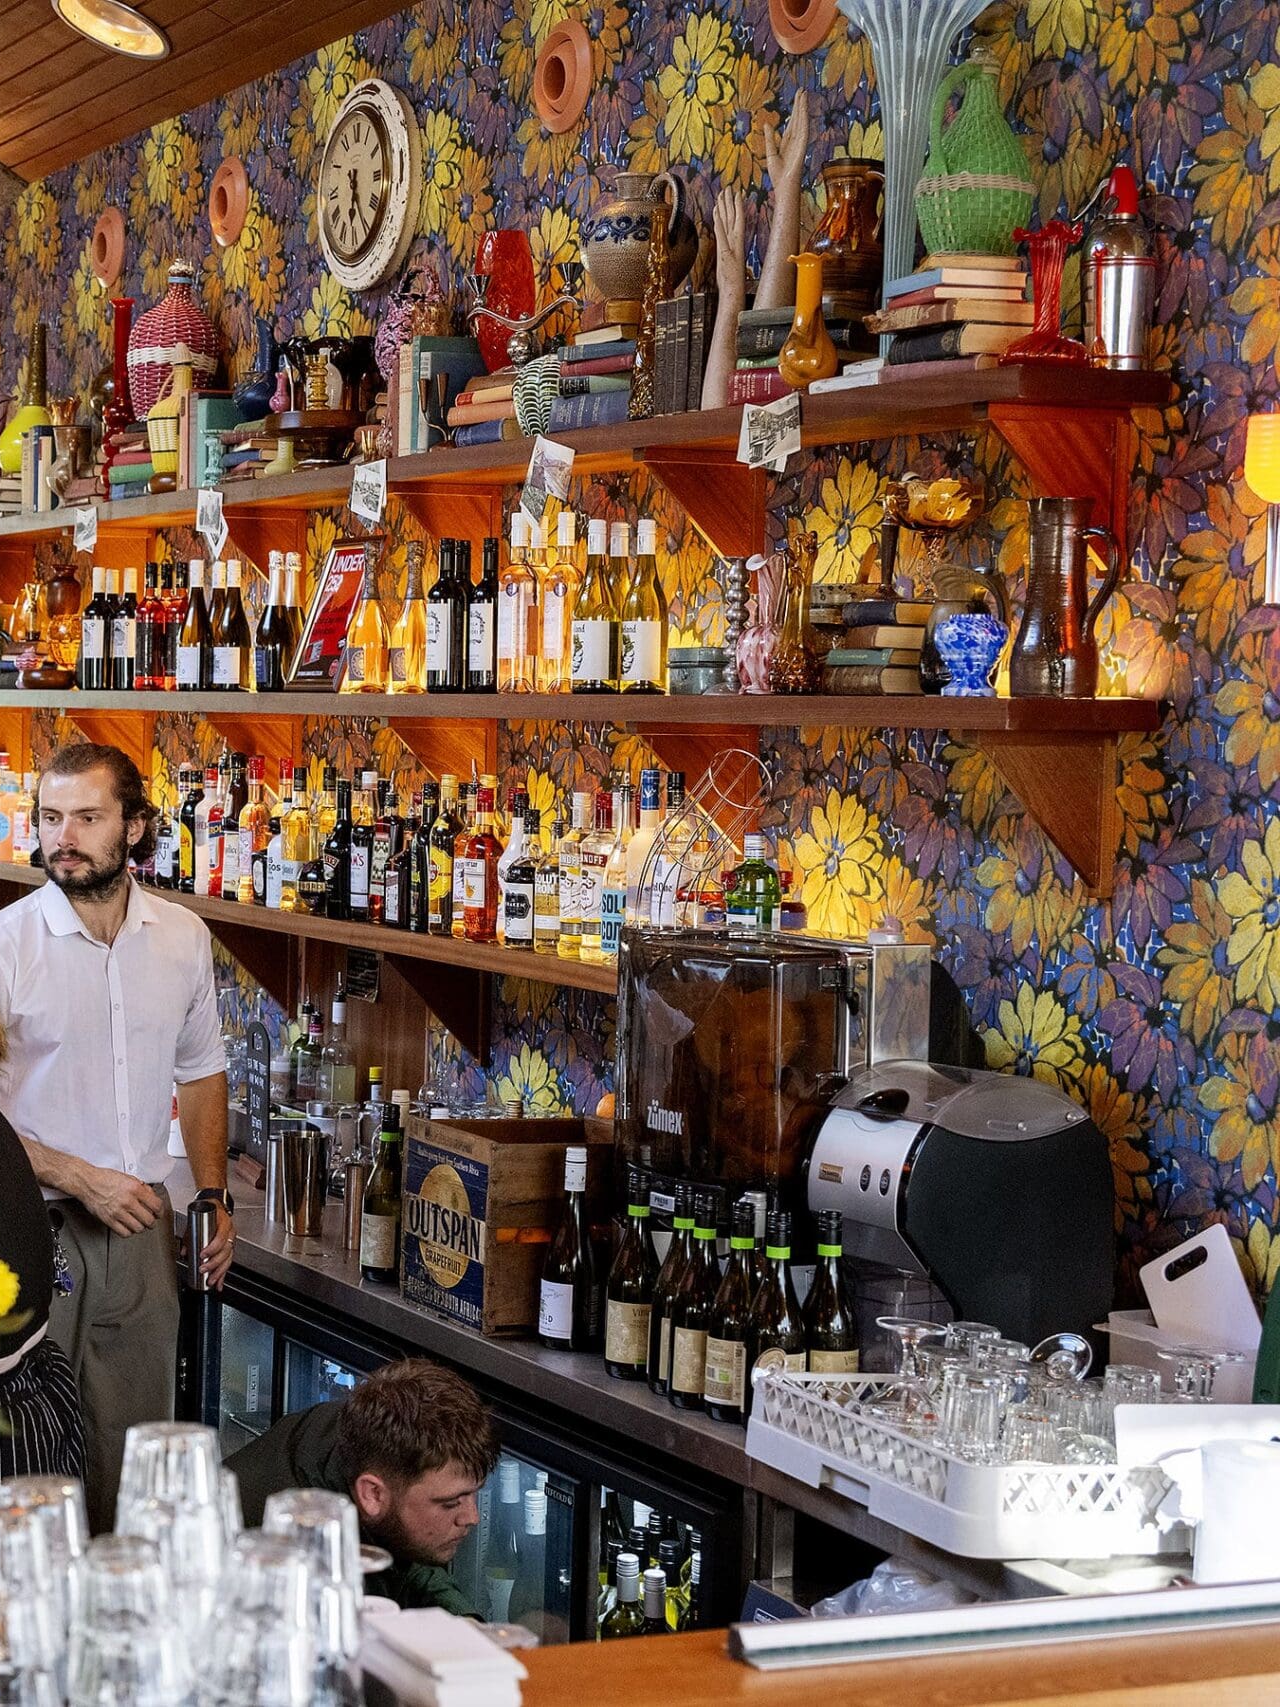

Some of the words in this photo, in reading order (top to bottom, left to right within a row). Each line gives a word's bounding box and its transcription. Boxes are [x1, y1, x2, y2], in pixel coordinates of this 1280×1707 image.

[647, 1099, 682, 1135] zümex
[409, 1199, 481, 1260] OUTSPAN
[425, 1247, 462, 1276] GRAPEFRUIT
